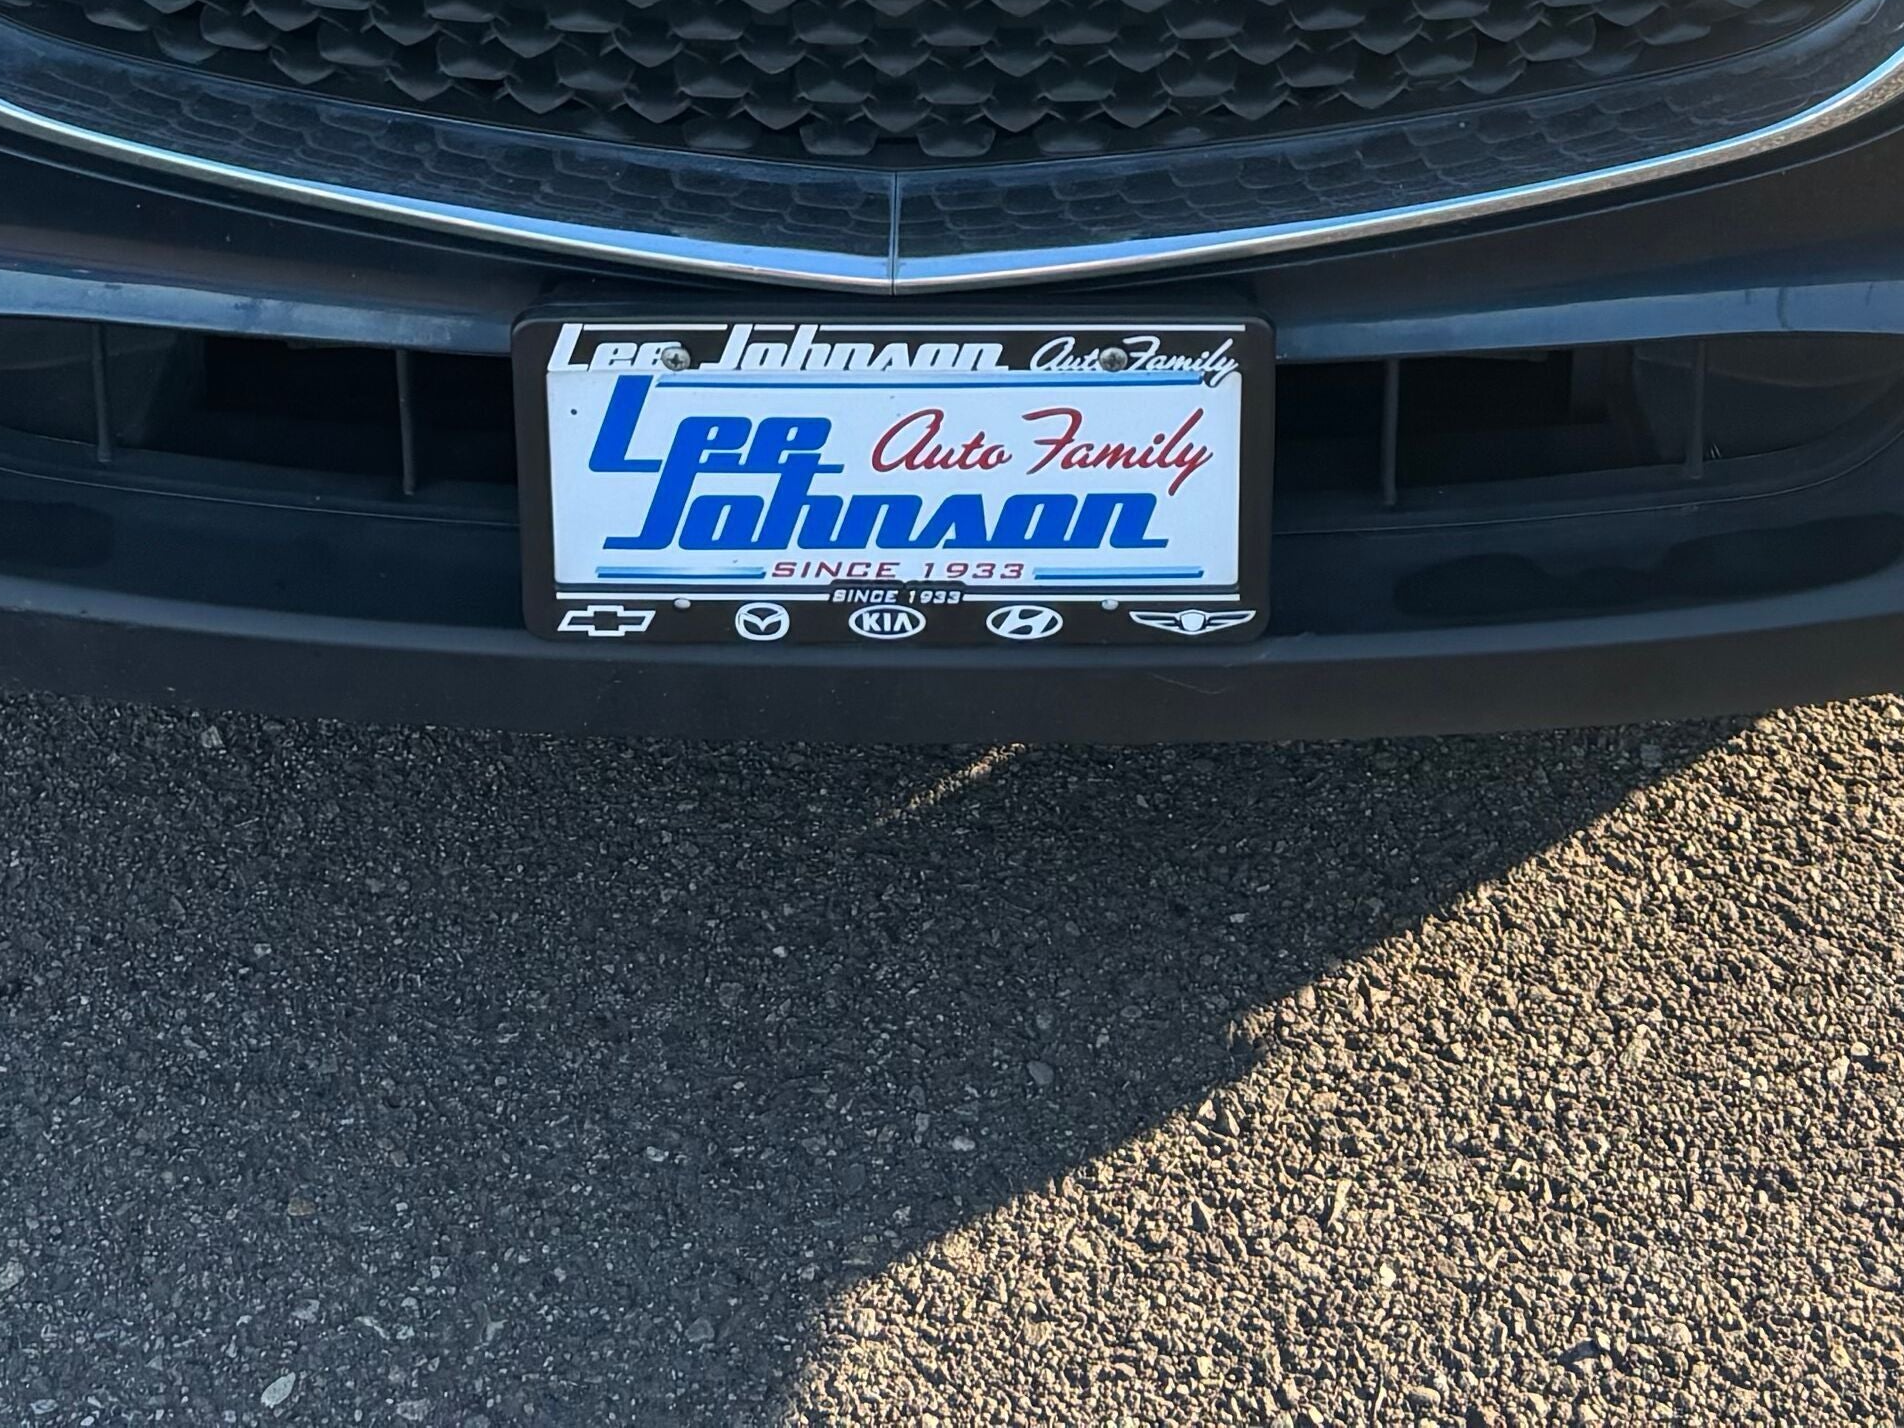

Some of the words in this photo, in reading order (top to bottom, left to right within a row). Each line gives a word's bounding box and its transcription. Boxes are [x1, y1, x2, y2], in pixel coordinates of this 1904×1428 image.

[547, 323, 684, 371] Lee
[698, 324, 1010, 371] Johnson
[1030, 336, 1108, 372] Aut
[1122, 335, 1239, 387] Family
[588, 375, 845, 473] Lee
[872, 408, 1013, 473] Auto
[1021, 407, 1214, 496] Family
[602, 453, 1169, 550] Johnson
[771, 561, 901, 578] SINCE
[924, 562, 1025, 579] 1933
[832, 589, 898, 603] SINCE
[908, 590, 962, 604] 1933
[862, 612, 913, 632] KIA
